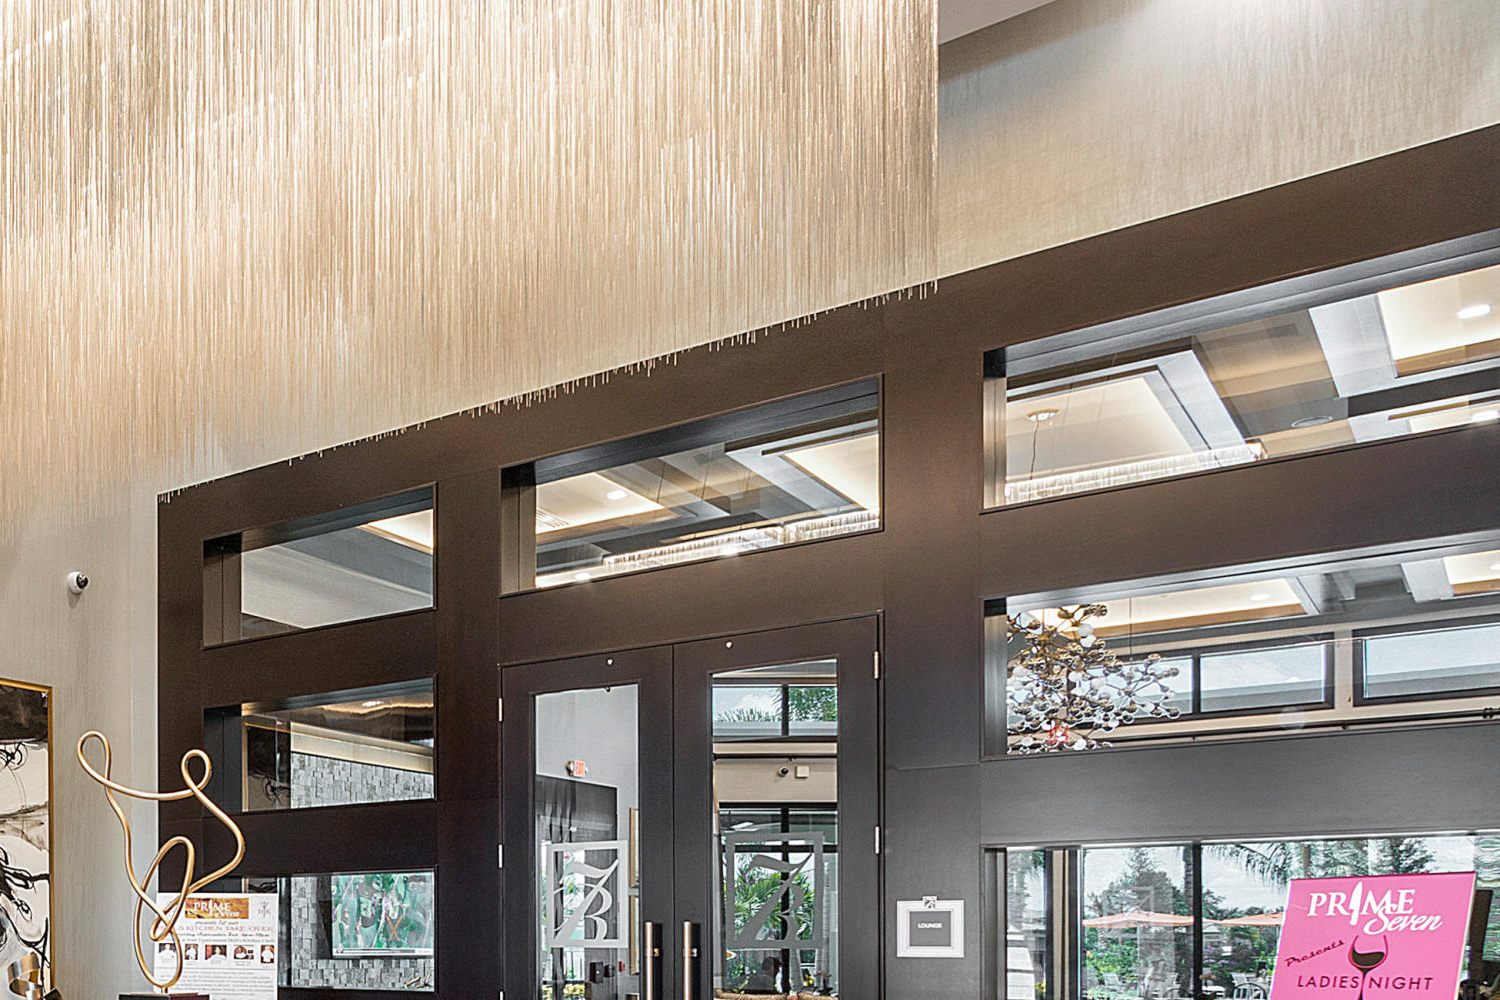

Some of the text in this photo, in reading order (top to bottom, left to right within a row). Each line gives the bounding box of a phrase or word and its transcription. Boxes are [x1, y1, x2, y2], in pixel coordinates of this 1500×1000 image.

[193, 899, 231, 916] PRIME
[1306, 881, 1417, 926] PRIME
[1363, 904, 1444, 936] Seven
[1284, 940, 1346, 968] Presents
[1297, 975, 1434, 991] LADIES NIGHT
